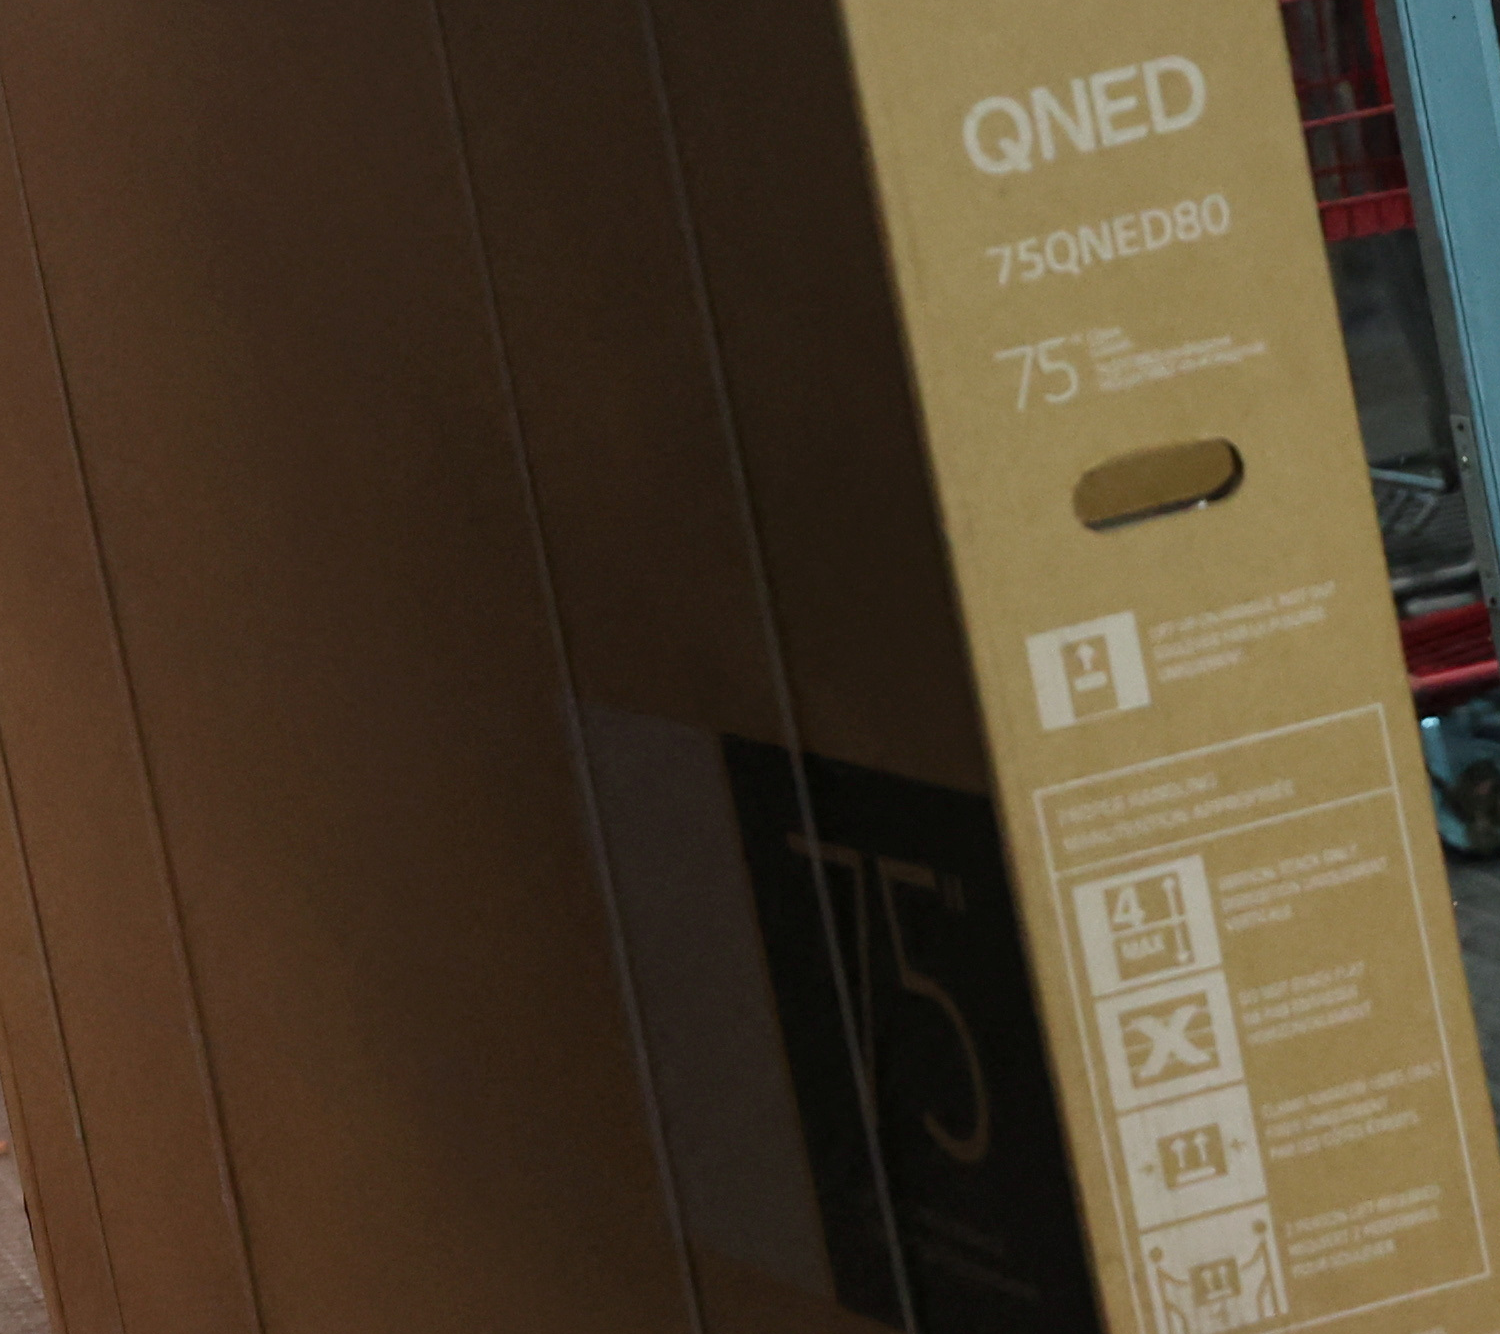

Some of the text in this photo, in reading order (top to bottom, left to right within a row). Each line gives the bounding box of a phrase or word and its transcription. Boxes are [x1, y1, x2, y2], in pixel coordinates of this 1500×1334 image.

[962, 54, 1207, 174] QNED
[986, 193, 1231, 286] 75QNED80
[1110, 884, 1147, 932] 4
